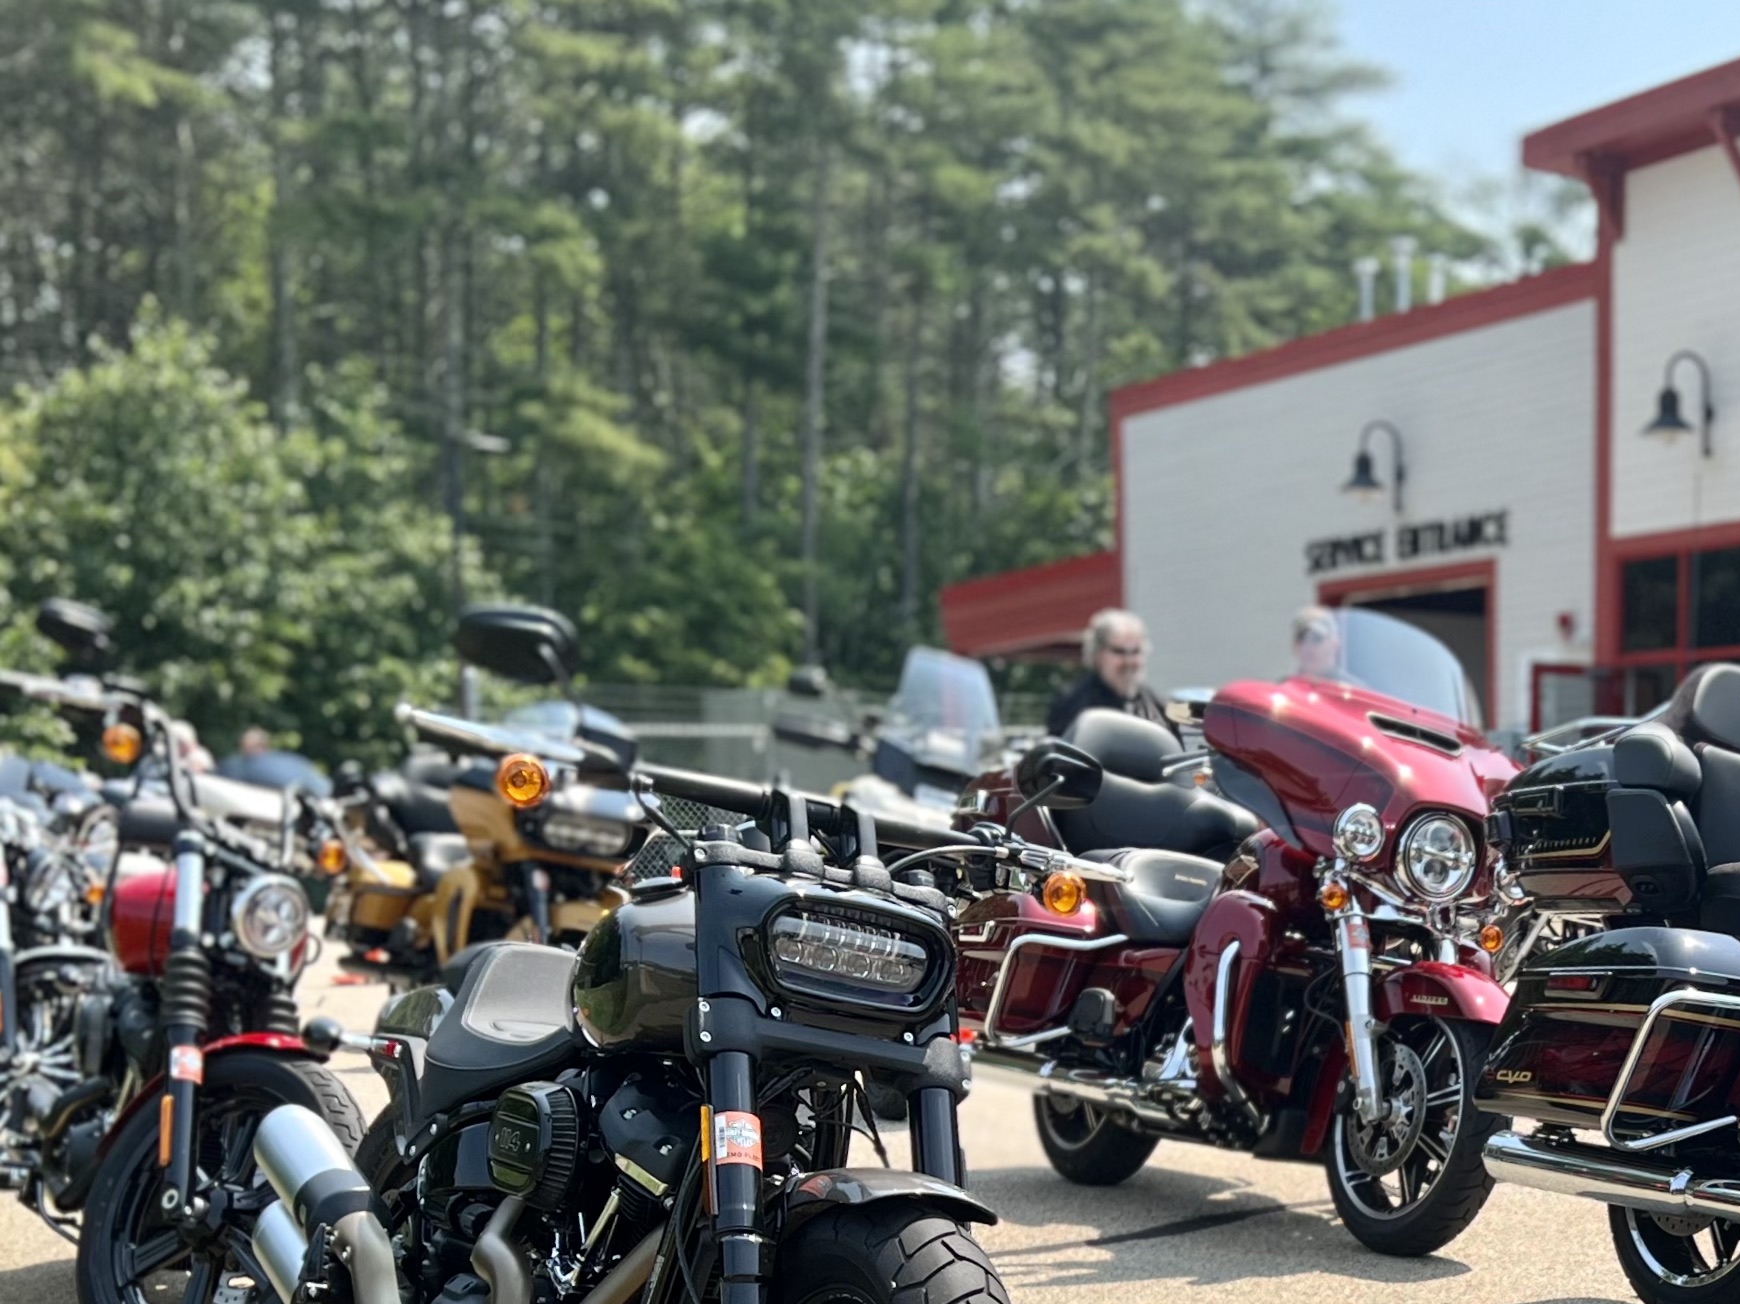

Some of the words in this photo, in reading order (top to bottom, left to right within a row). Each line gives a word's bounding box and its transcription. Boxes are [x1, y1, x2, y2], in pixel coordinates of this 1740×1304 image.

[1305, 532, 1384, 574] SERVICE
[1397, 511, 1507, 560] ENTRANCE
[1496, 1070, 1532, 1084] CVO
[500, 1126, 521, 1152] 114
